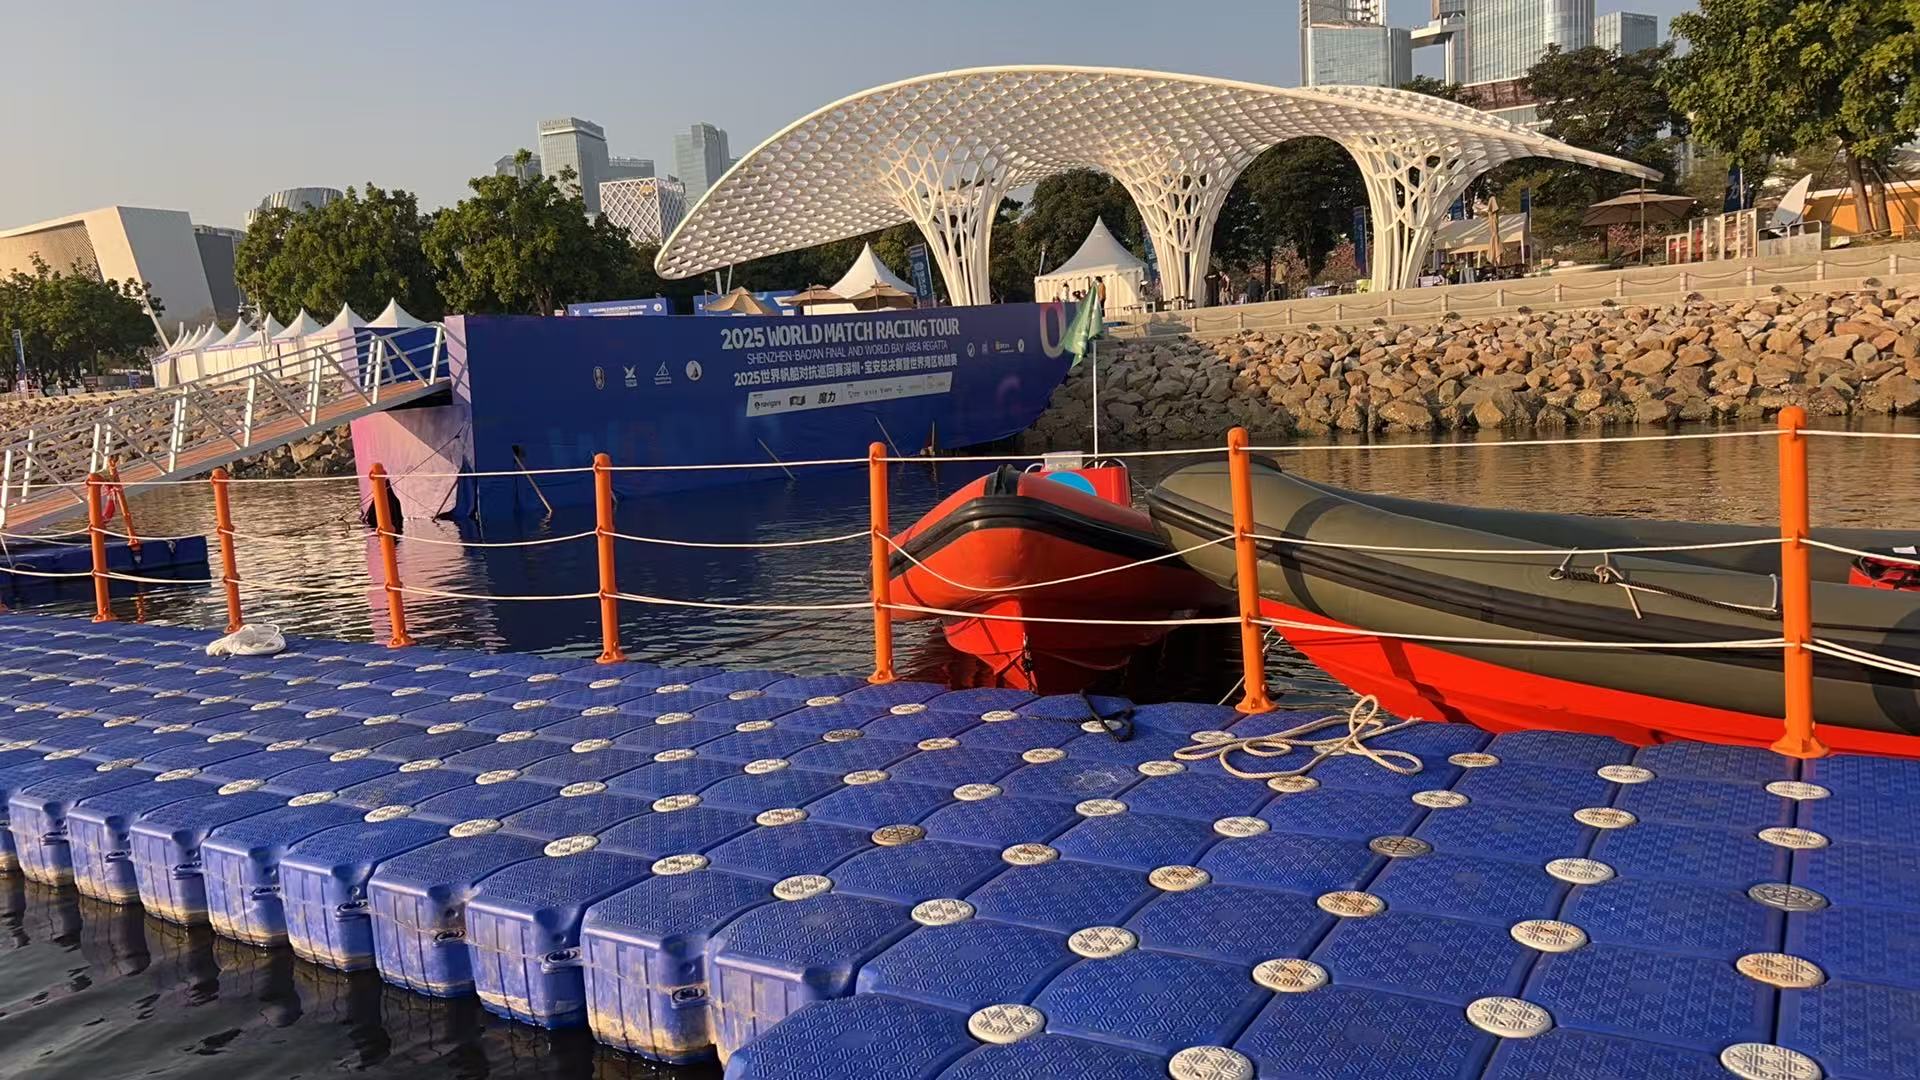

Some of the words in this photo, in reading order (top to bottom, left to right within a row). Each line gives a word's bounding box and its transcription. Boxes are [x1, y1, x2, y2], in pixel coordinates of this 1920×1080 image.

[720, 327, 766, 350] 2025
[766, 324, 823, 347] WORLD
[823, 319, 873, 343] MATCH
[875, 318, 928, 340] RACING
[928, 317, 961, 337] TOUR
[825, 347, 846, 359] FINAL
[848, 345, 863, 357] AND
[864, 343, 890, 356] WORLD
[891, 342, 905, 353] BAY
[905, 341, 921, 353] AREA
[922, 339, 949, 351] REGATTA
